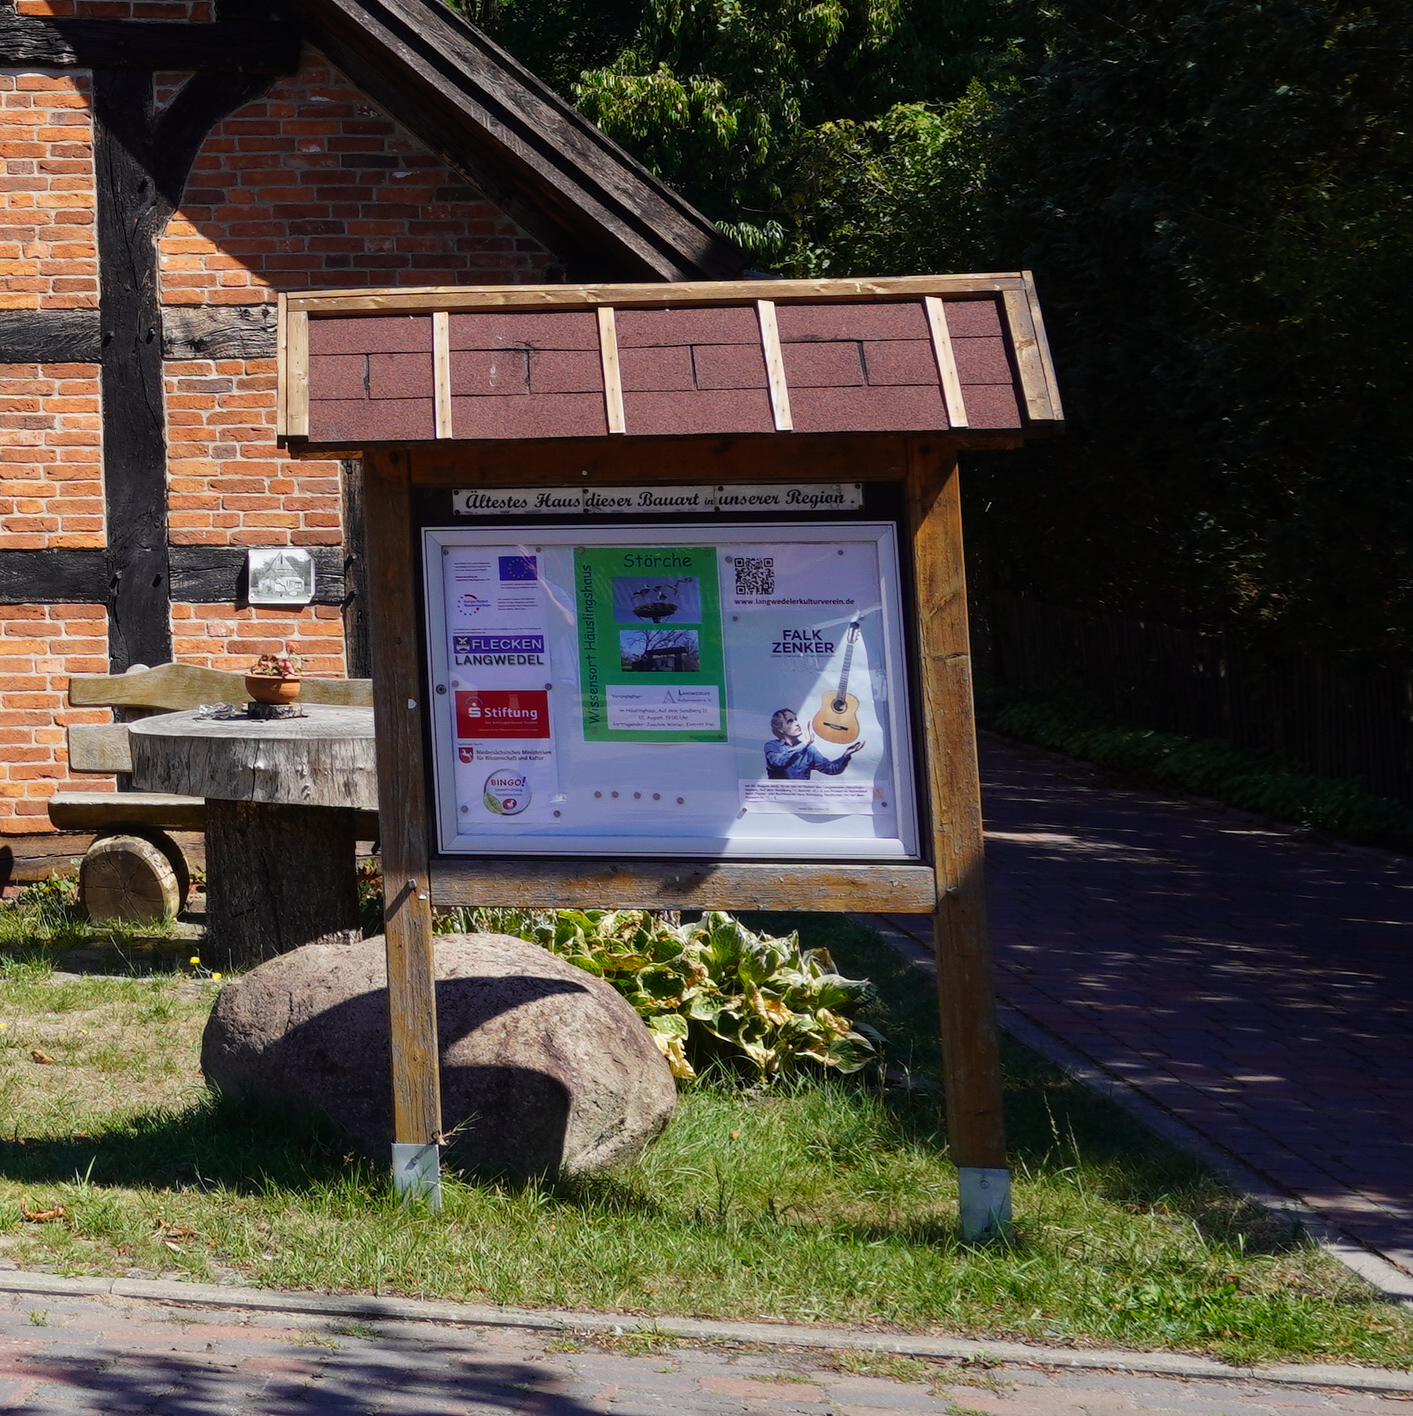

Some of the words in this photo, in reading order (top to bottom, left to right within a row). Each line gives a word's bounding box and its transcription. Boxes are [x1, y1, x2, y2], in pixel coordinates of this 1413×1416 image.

[465, 490, 527, 509] Ältestes
[534, 493, 581, 508] Haus
[584, 492, 633, 507] dieser
[637, 491, 700, 507] Bauart
[704, 497, 714, 506] in
[718, 493, 780, 506] unserer
[623, 552, 693, 568] Störche
[581, 564, 597, 650] Häuslingshaus
[734, 597, 855, 606] www.langwedelerkulturverein.de
[782, 629, 823, 641] FALK
[472, 638, 542, 650] FLECKEN
[772, 642, 835, 654] ZENKER
[455, 654, 545, 666] LANGWEDEL
[585, 654, 600, 724] Wissensort
[484, 706, 538, 720] Stiftung
[490, 776, 527, 787] BINGO!
